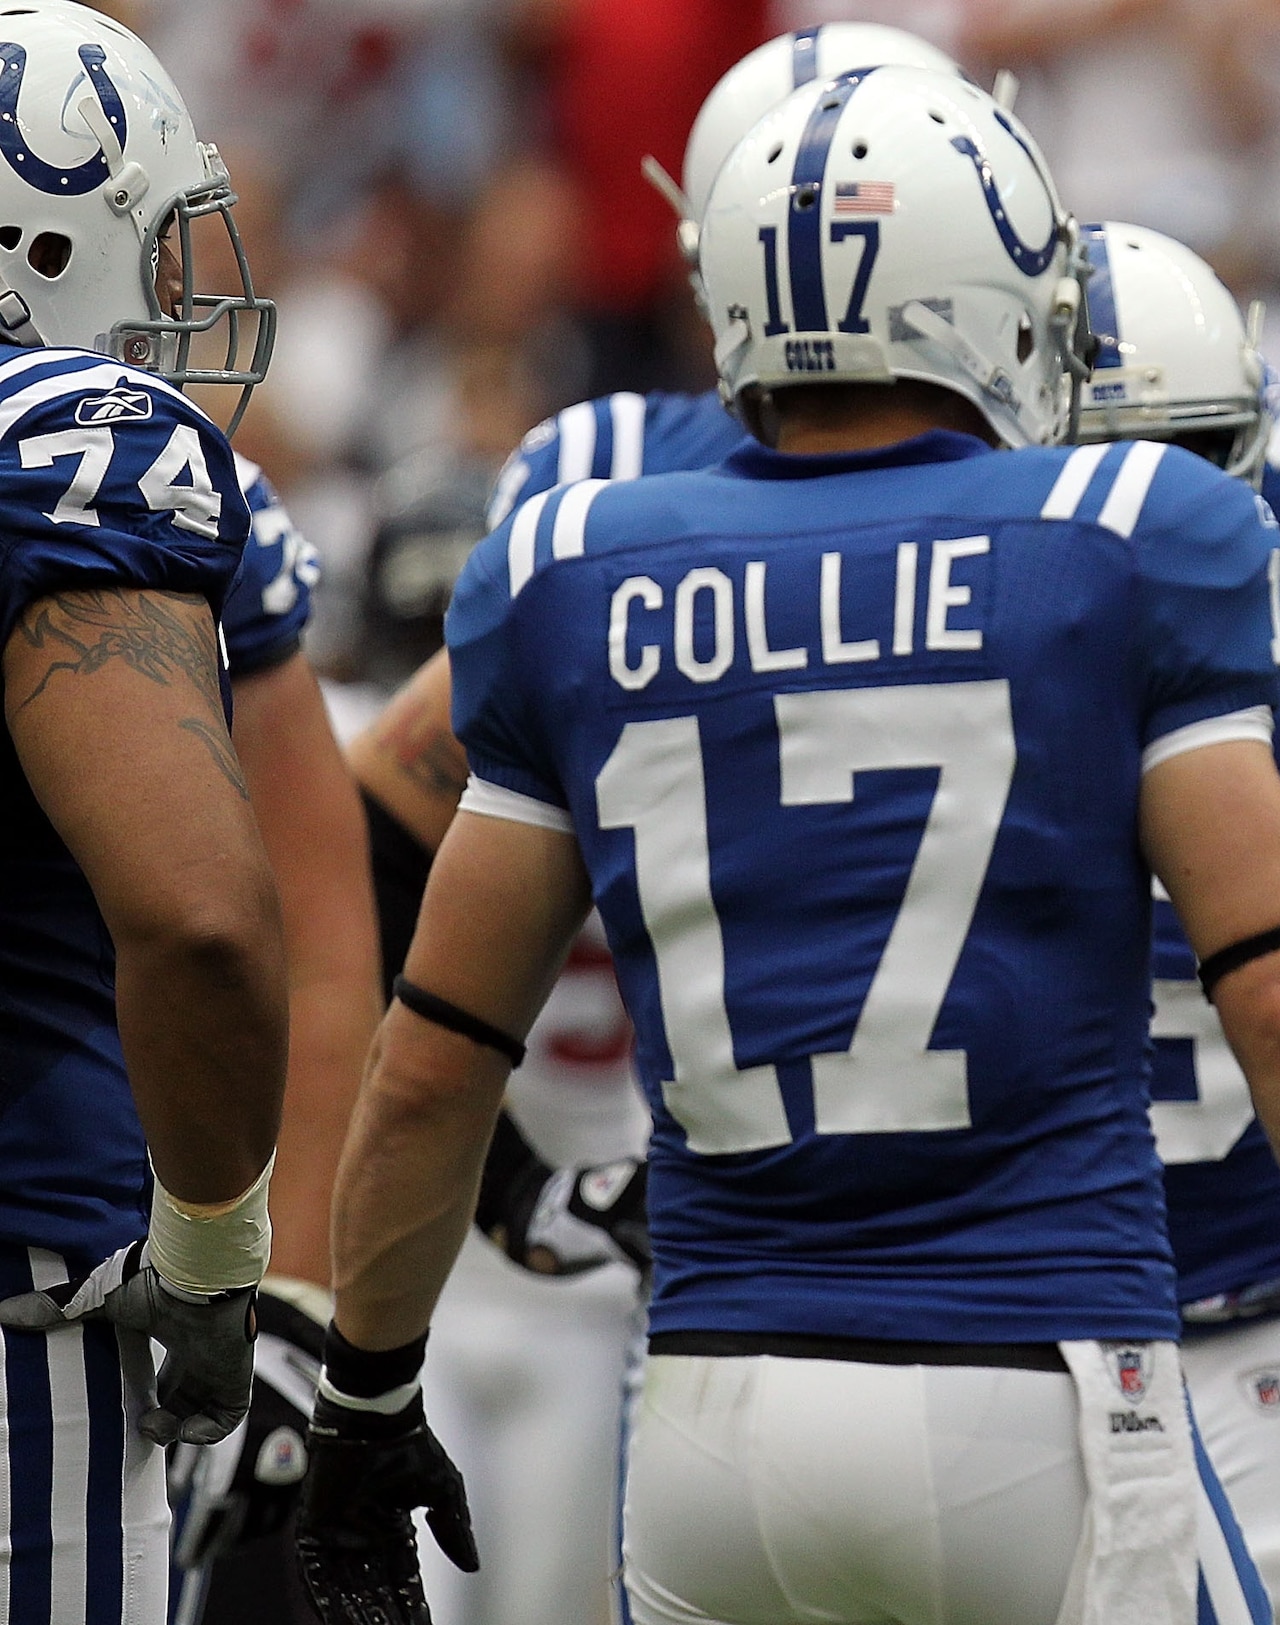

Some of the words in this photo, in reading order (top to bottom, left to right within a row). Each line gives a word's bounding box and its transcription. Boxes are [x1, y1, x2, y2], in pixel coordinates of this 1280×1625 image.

[759, 221, 880, 337] 17
[785, 340, 837, 371] COLTS
[19, 424, 222, 540] 74
[609, 535, 990, 691] COLLIE
[596, 678, 1018, 1156] 17
